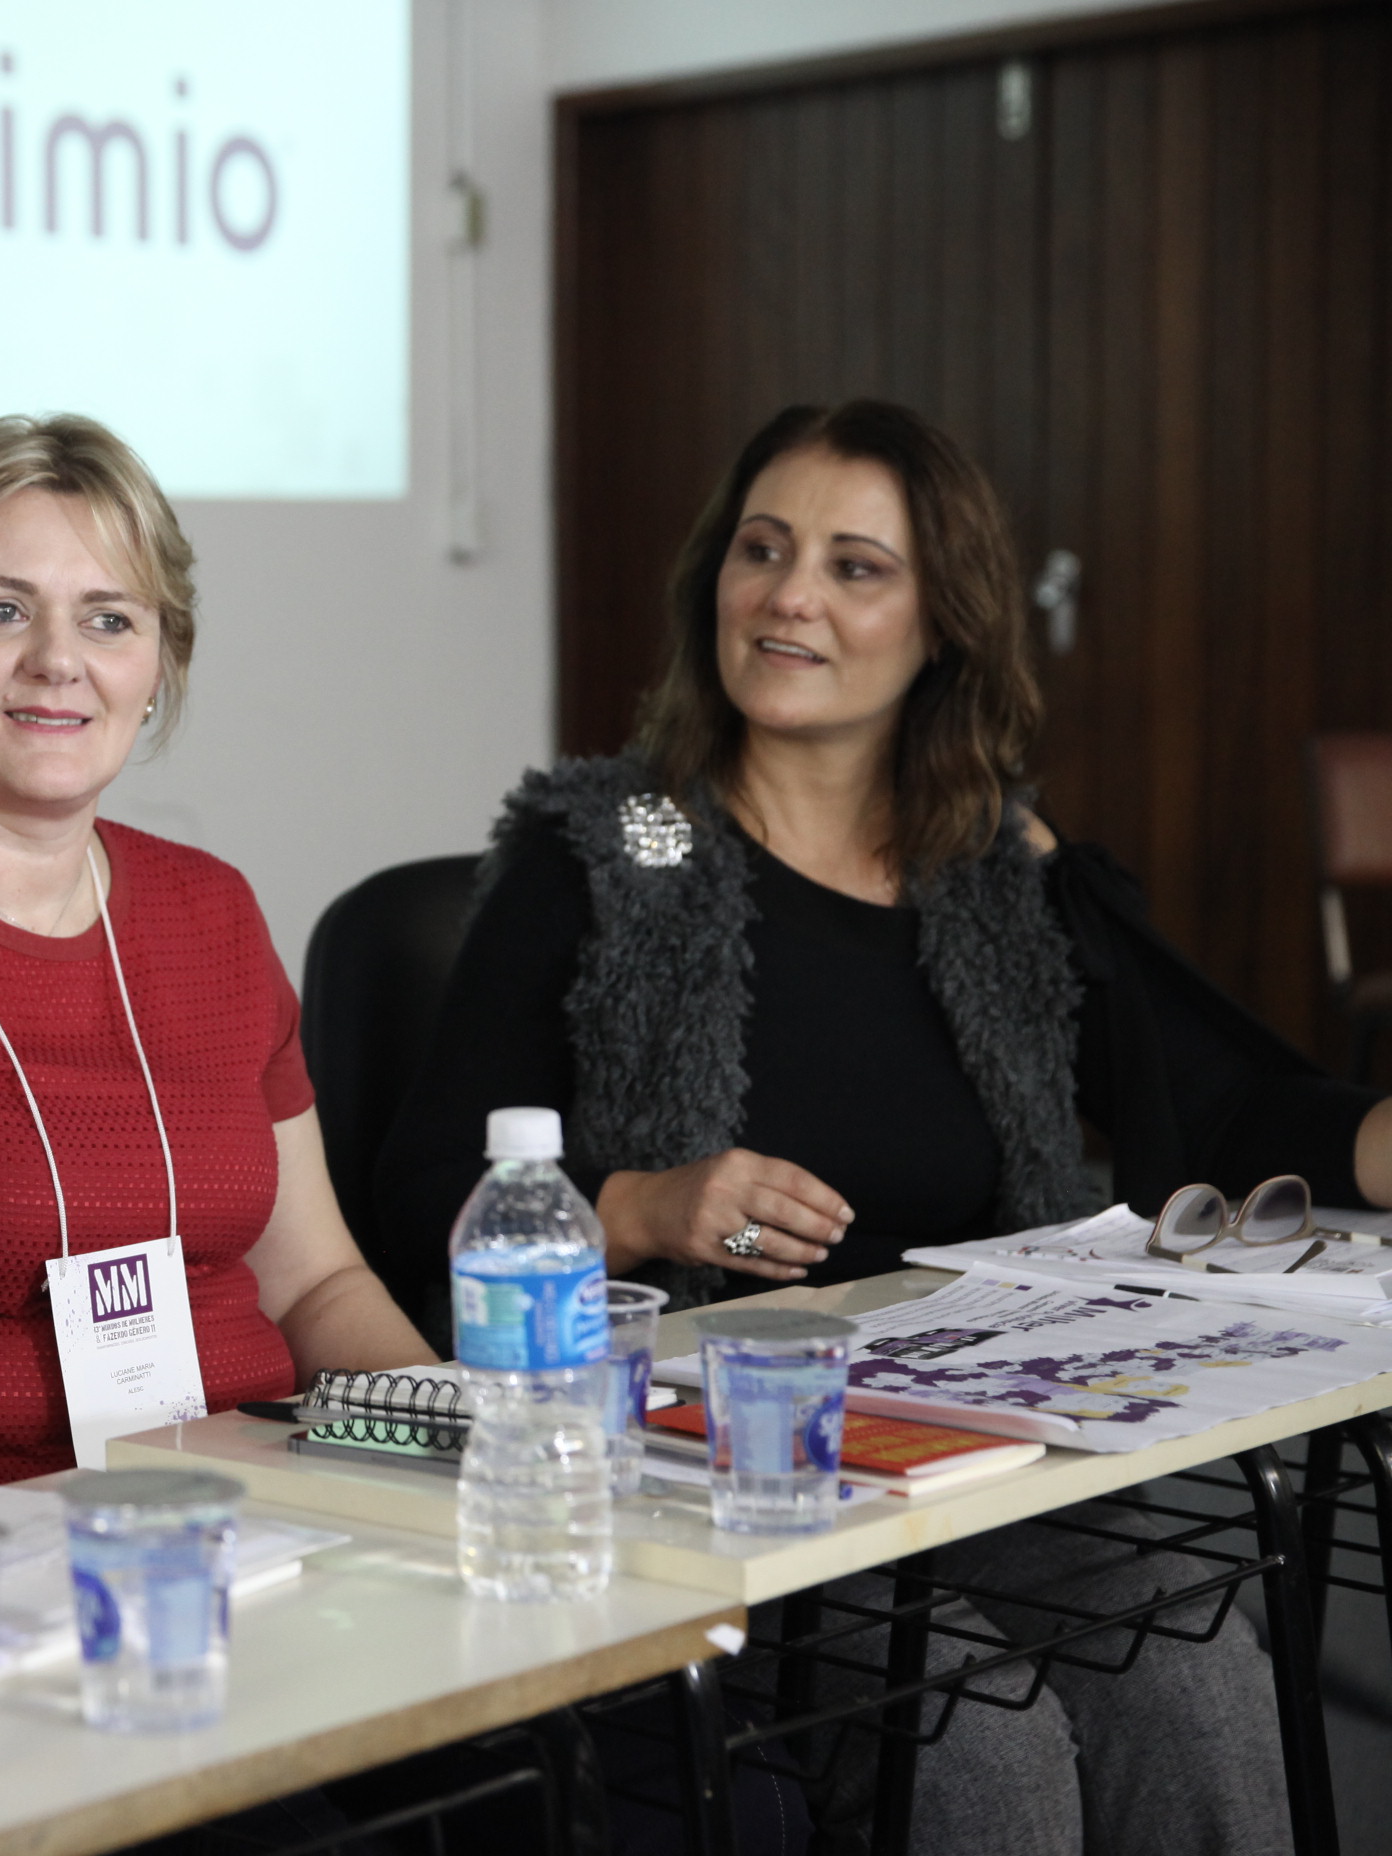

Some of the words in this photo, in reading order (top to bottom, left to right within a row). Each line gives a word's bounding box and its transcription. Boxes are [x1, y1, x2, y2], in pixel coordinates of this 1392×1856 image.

[94, 1260, 148, 1316] MM
[111, 1367, 135, 1378] LUCIANE
[136, 1363, 155, 1372] MARIA
[117, 1371, 151, 1384] CARMINATTI
